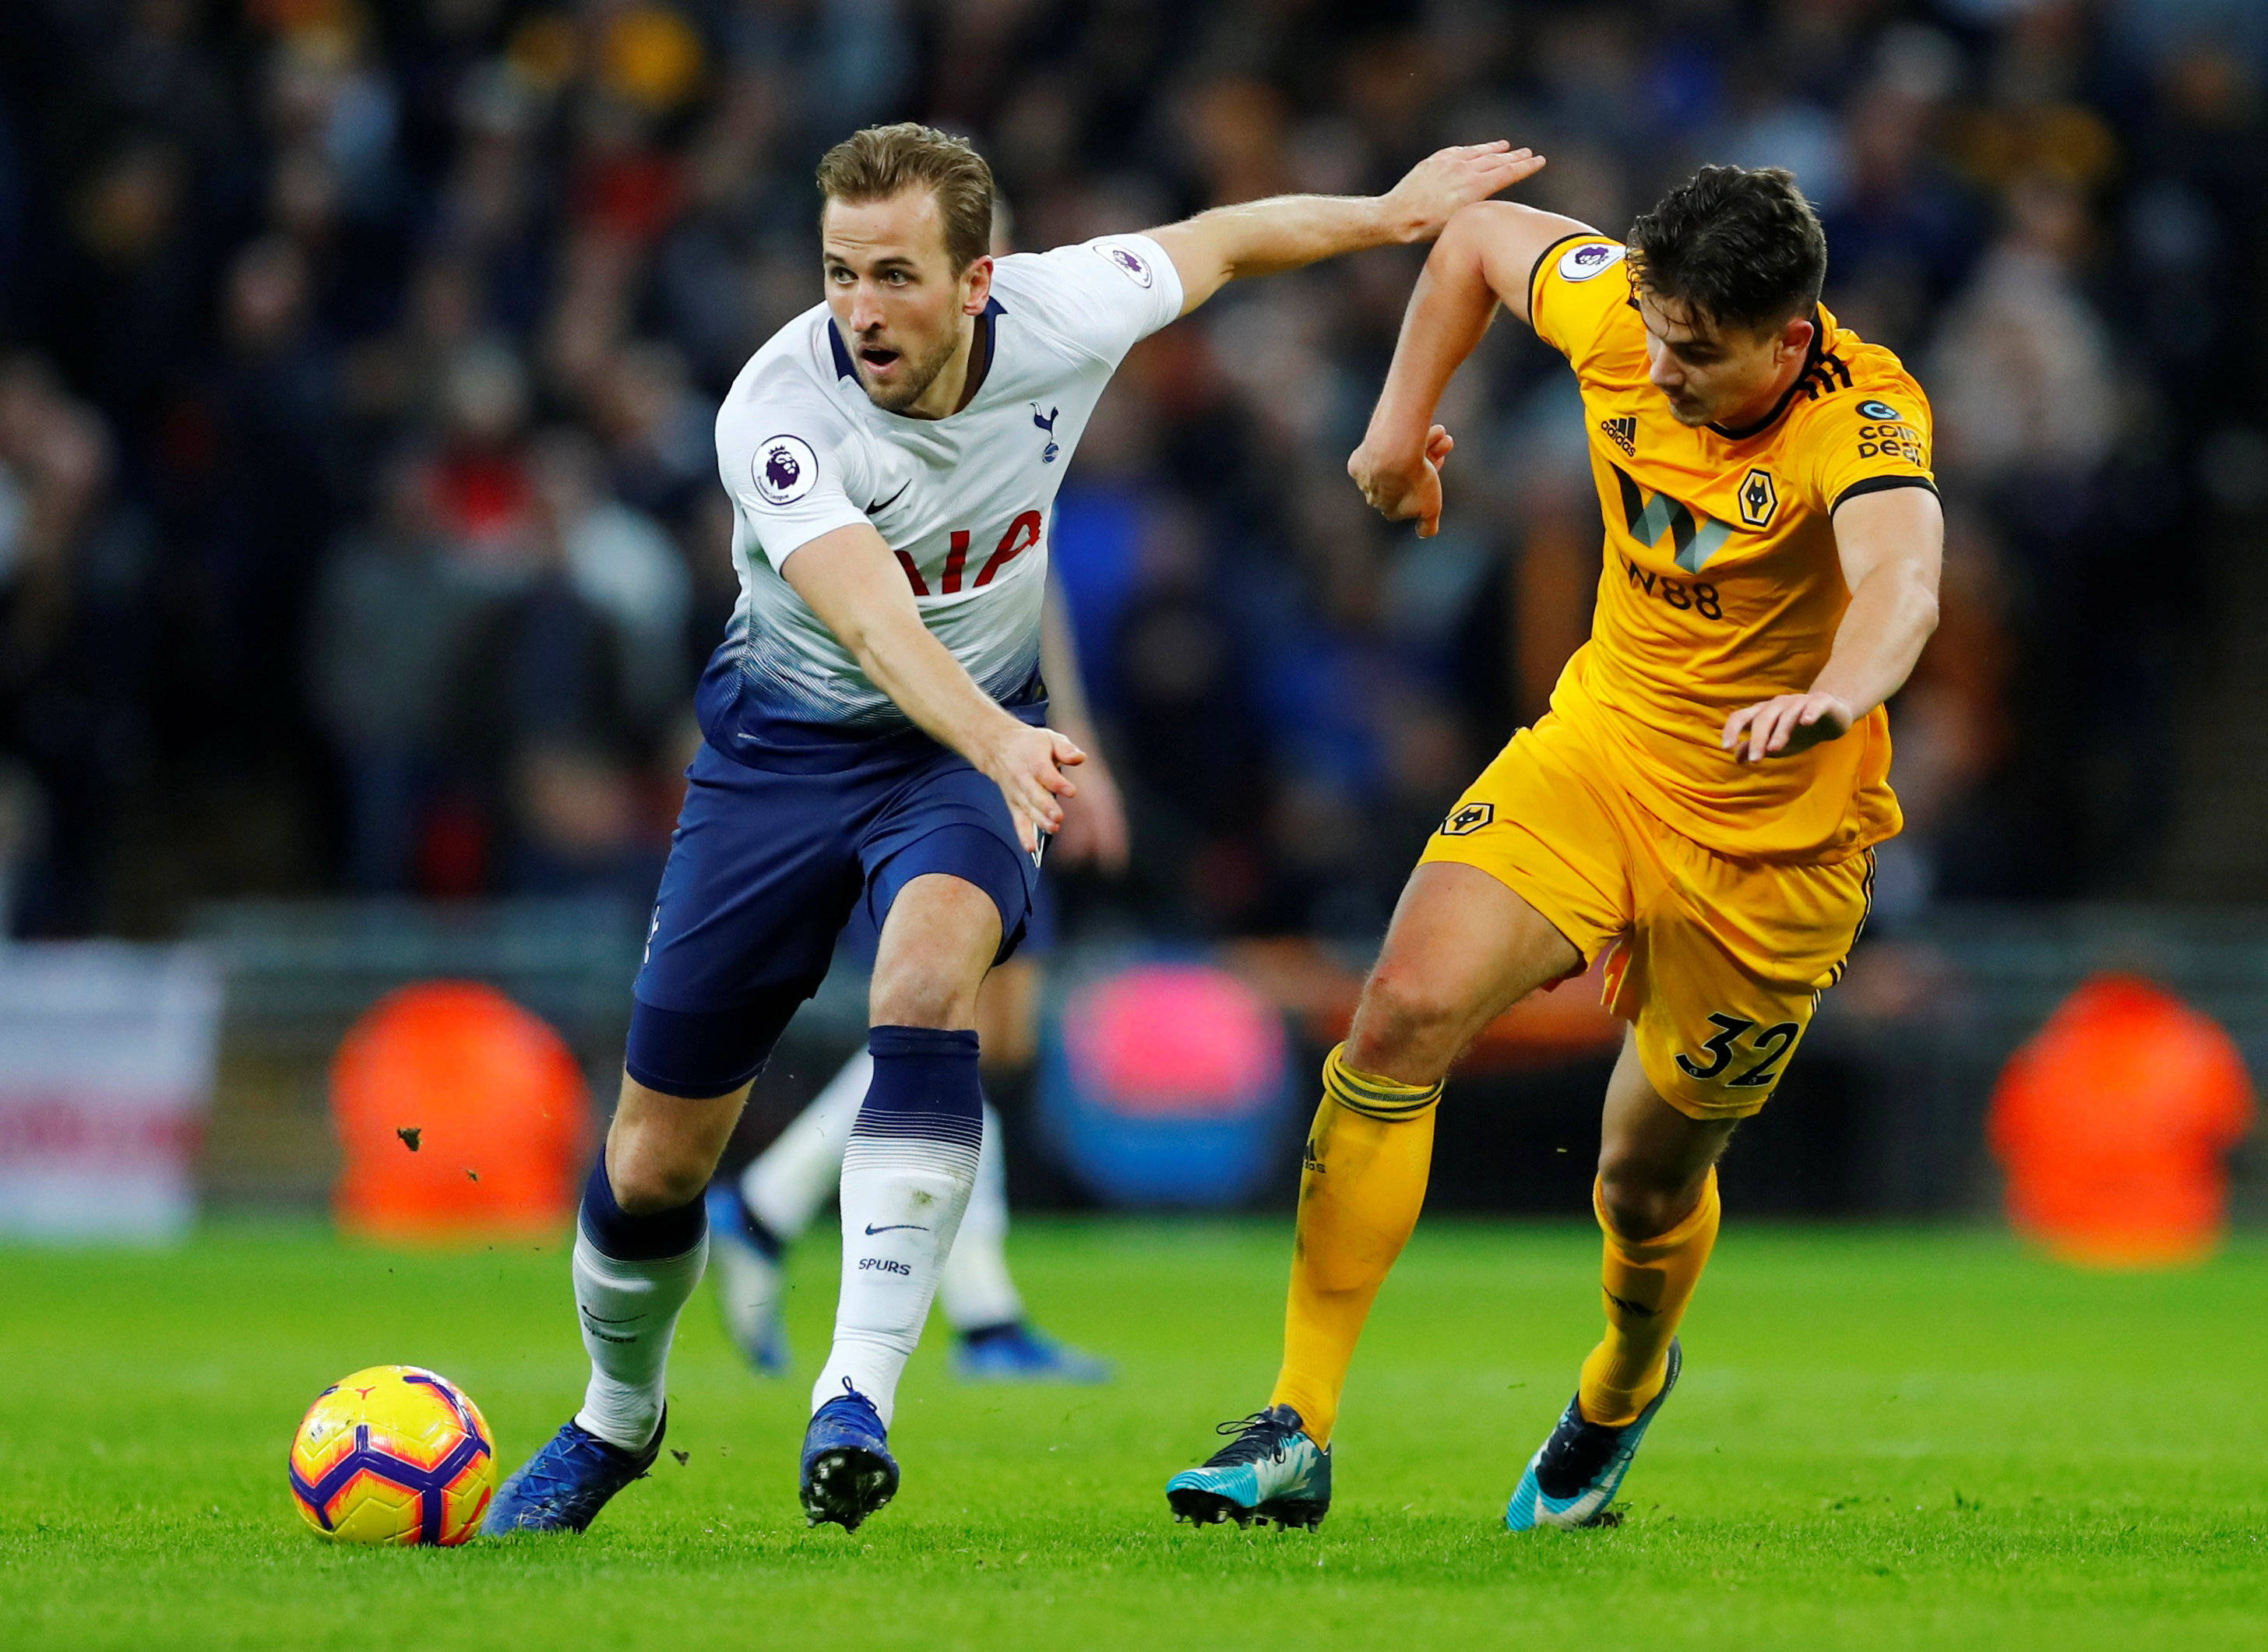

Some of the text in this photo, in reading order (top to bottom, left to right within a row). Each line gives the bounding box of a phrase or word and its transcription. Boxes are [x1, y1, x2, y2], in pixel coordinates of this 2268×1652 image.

[1601, 421, 1636, 457] adidas
[1675, 1011, 1800, 1087] 32
[858, 1258, 911, 1276] SPURS
